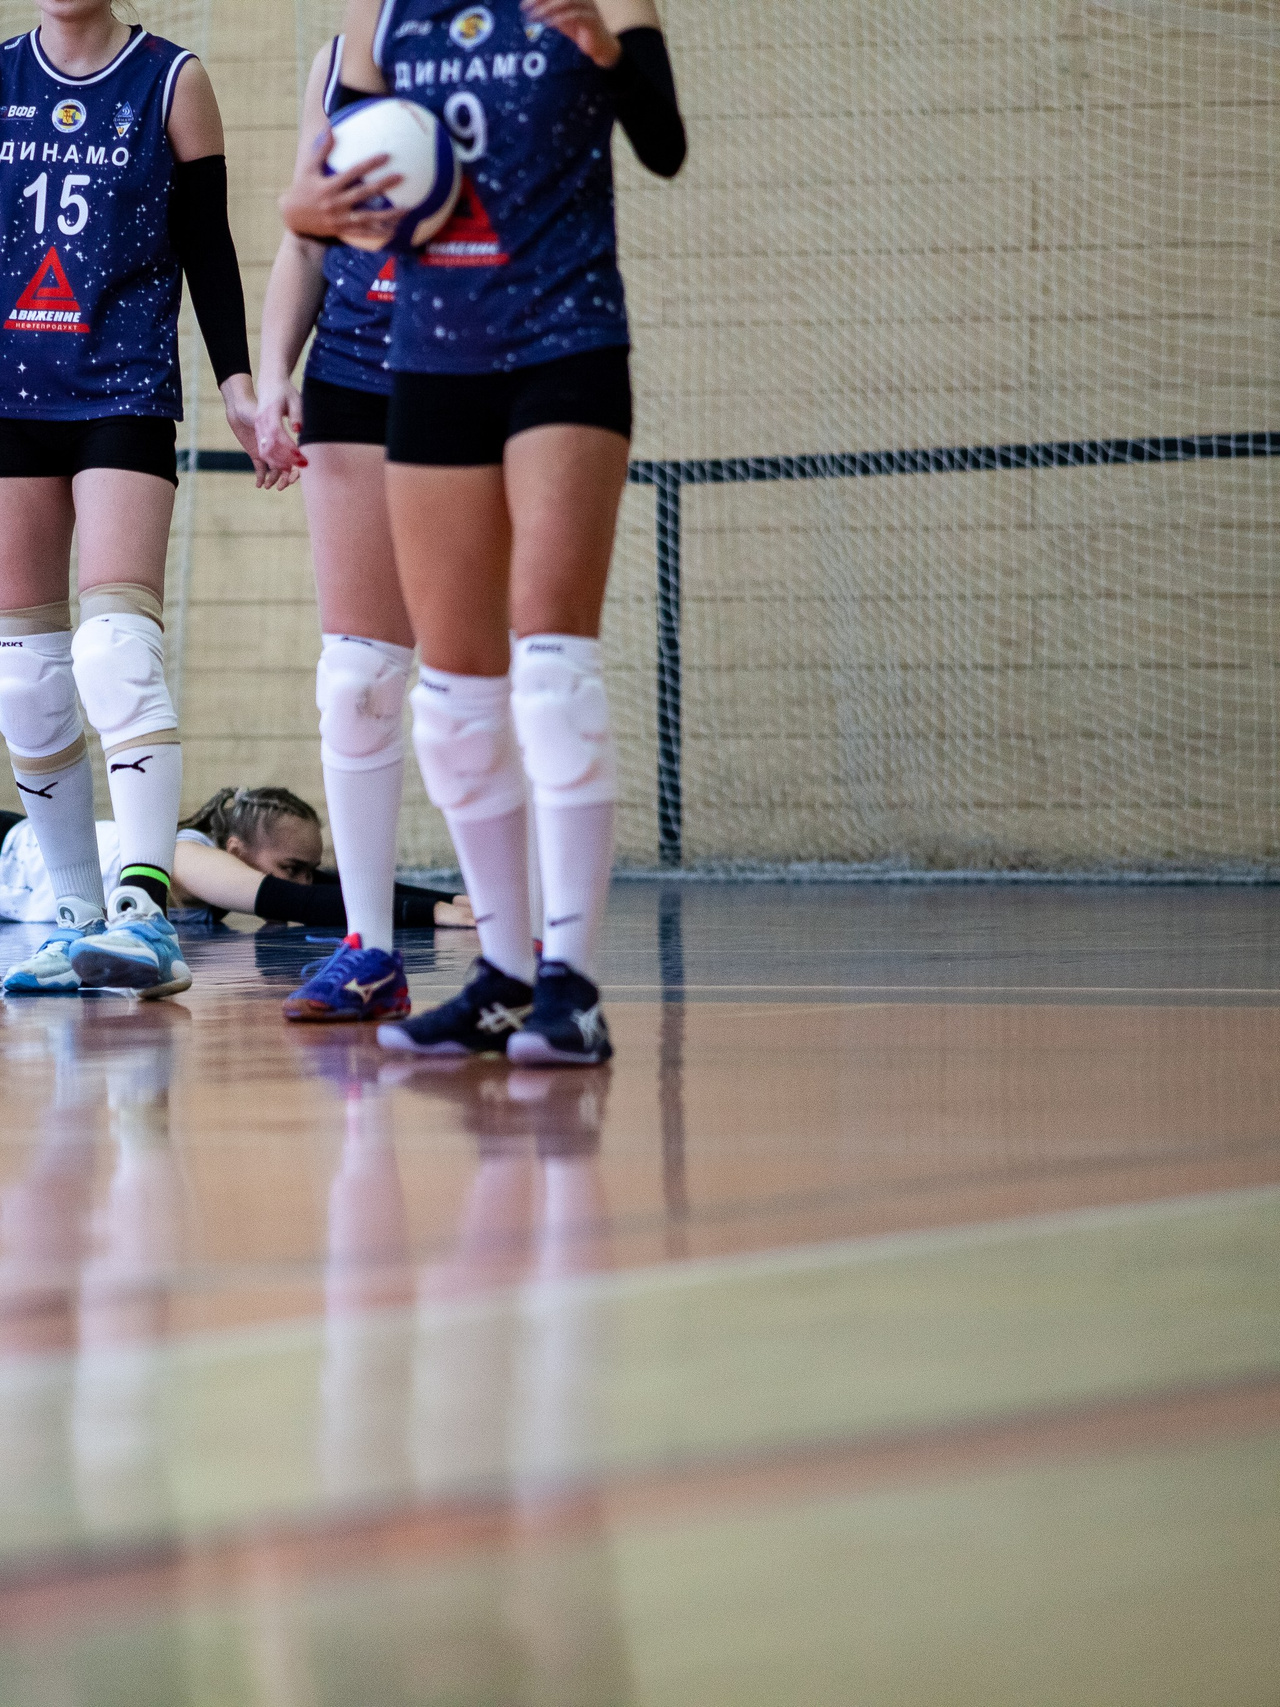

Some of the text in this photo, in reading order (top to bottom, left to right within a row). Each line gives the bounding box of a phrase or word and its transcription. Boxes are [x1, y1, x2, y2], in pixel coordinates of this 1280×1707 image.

[395, 51, 547, 91] ДИНАМО
[7, 105, 37, 118] ВФВ
[443, 91, 488, 163] 9
[23, 172, 90, 236] 15
[8, 309, 81, 322] ДВИЖЕНИЕ
[15, 322, 77, 331] НЕФТЕПРОДУКТ
